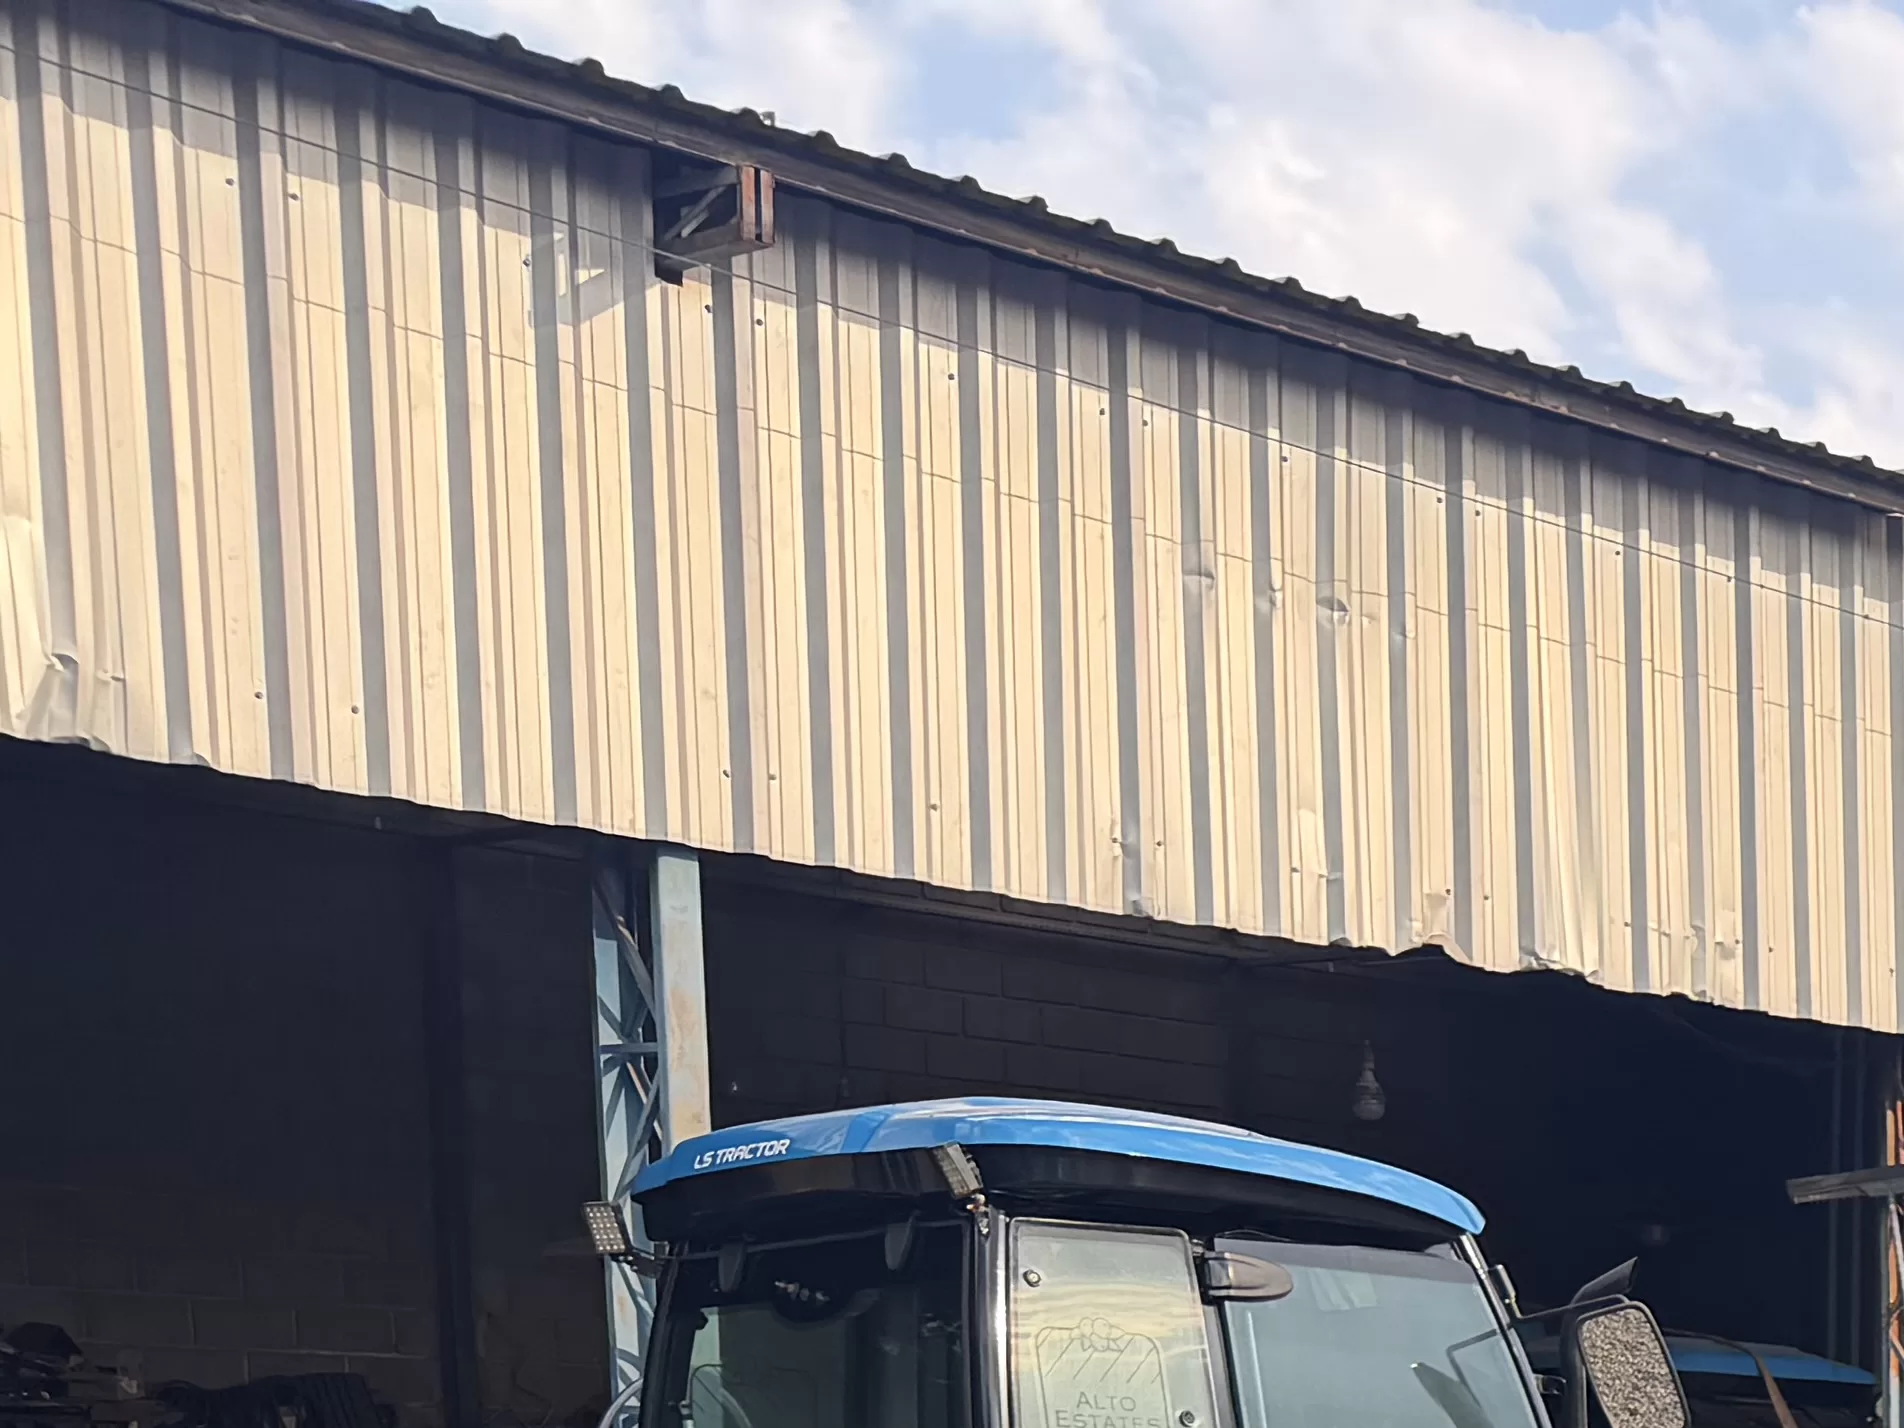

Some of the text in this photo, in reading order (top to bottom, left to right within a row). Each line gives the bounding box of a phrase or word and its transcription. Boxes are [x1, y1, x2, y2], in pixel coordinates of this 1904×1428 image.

[694, 1139, 790, 1170] LS TRACTOR
[1076, 1391, 1137, 1412] ALTO
